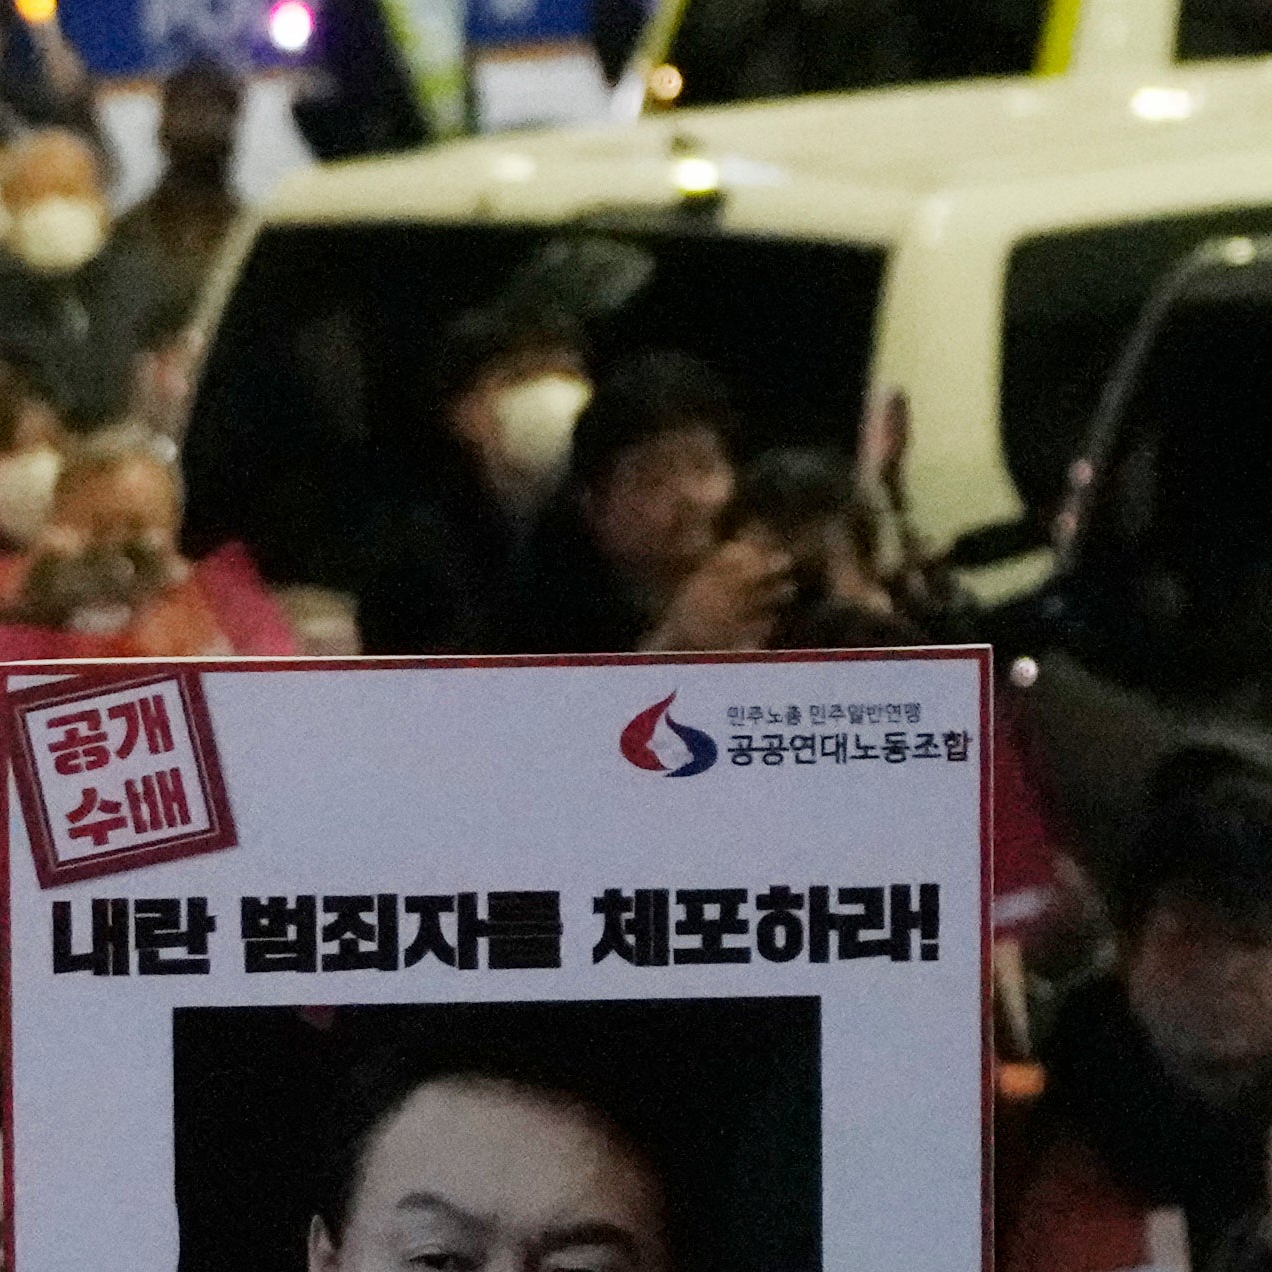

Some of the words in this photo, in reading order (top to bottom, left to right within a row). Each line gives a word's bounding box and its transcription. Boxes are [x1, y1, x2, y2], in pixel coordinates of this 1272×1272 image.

[46, 695, 175, 775] 공개
[727, 729, 973, 766] 공공연대노동조합
[66, 767, 191, 846] 수배
[52, 896, 218, 976] 내란
[241, 890, 563, 973] 범죄자를
[592, 883, 941, 967] 체포하라!
